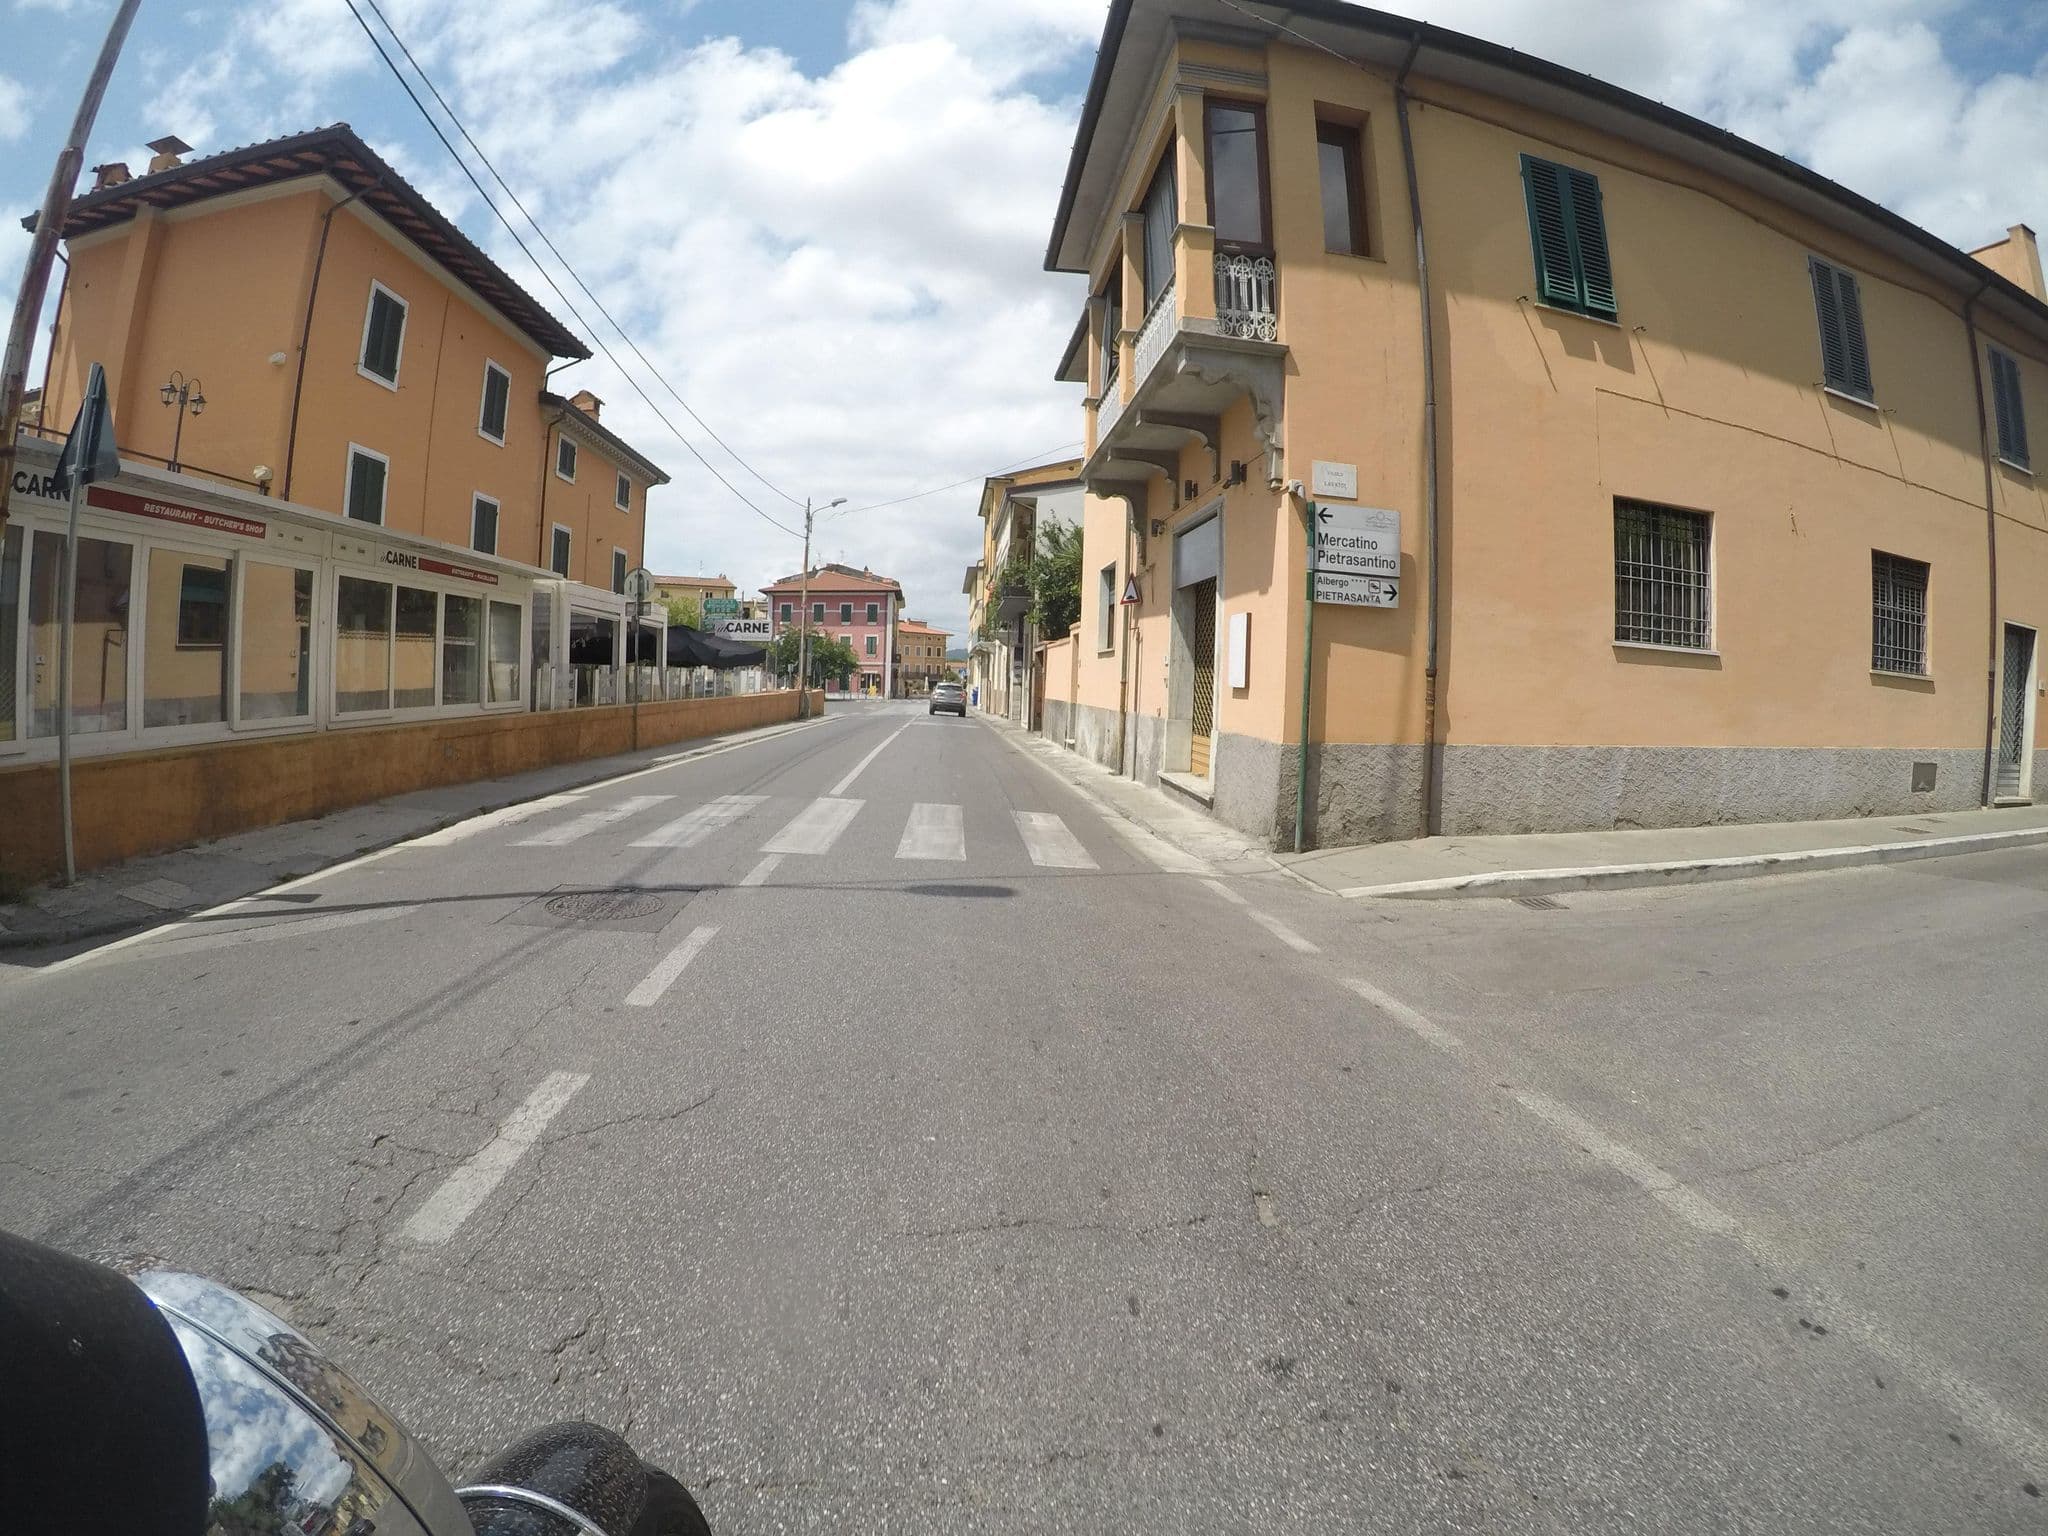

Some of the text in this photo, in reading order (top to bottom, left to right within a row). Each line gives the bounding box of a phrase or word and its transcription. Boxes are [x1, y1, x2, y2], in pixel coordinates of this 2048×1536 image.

[12, 470, 83, 504] CARN
[143, 503, 198, 521] RESTAURANT
[203, 515, 245, 530] BUTCHER'S
[245, 523, 264, 534] SHOP
[1318, 532, 1378, 551] Mercatino
[386, 550, 417, 569] CARNE
[1317, 549, 1396, 570] Pietrasantino
[1316, 575, 1349, 588] Albergo
[1316, 590, 1381, 605] PIETRASANTA
[726, 622, 769, 633] CARNE
